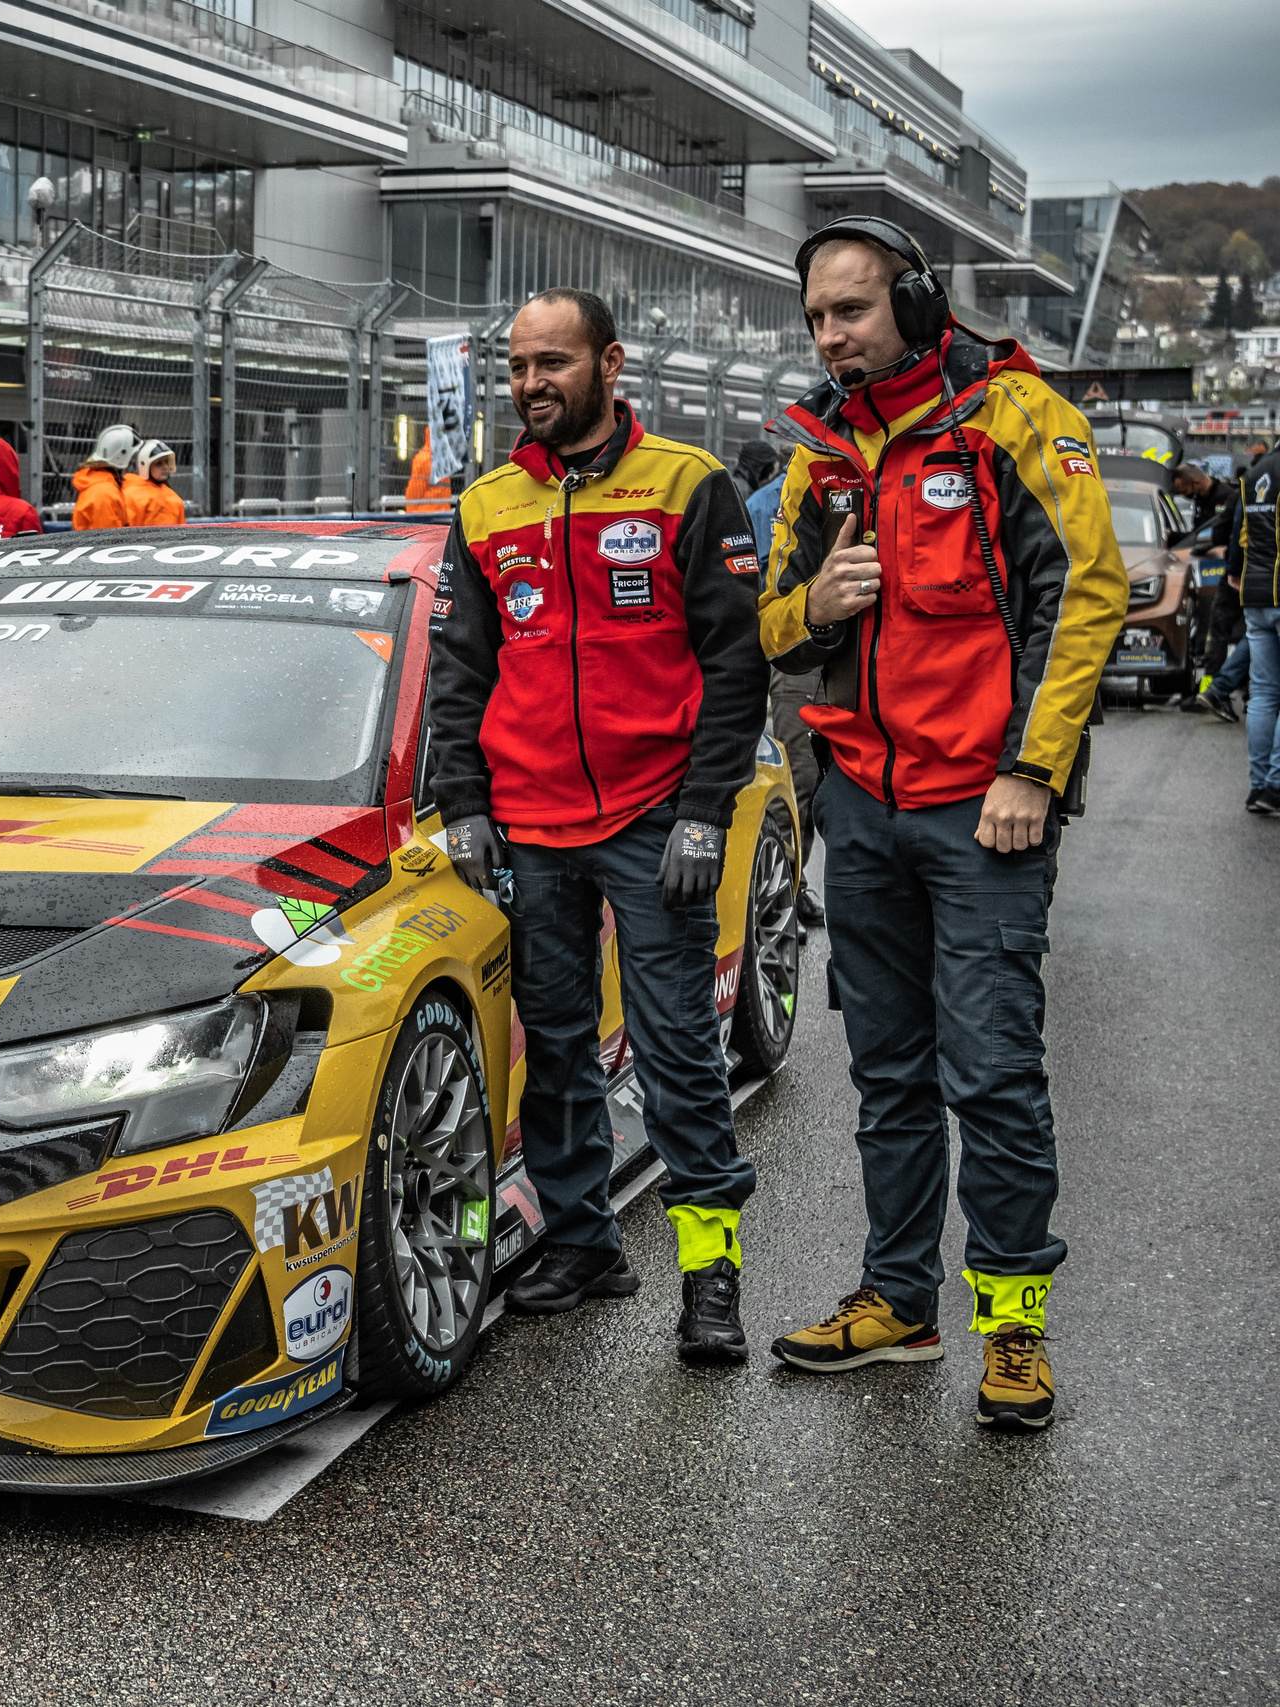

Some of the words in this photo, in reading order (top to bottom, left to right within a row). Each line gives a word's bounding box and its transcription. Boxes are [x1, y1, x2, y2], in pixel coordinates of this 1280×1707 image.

[611, 486, 656, 500] DHL
[520, 500, 538, 511] Sport
[604, 533, 657, 550] eurol
[500, 556, 533, 571] PRESTIGE
[224, 584, 272, 593] CIAO
[612, 579, 649, 588] TRICORP
[911, 582, 954, 594] comtoyou
[219, 592, 315, 604] MARCELA
[513, 596, 532, 610] ASC
[615, 597, 651, 606] WORKWEAR
[602, 613, 642, 622] comtoyou
[682, 849, 718, 860] MaxiFlex
[340, 902, 468, 993] GREENTECH
[95, 1145, 268, 1201] DHL
[281, 1172, 362, 1261] KW
[285, 1228, 359, 1273] kwsuspensions.de
[494, 1225, 522, 1268] ÖHLINS
[1021, 1283, 1049, 1310] 02
[286, 1286, 349, 1343] eurol
[287, 1317, 349, 1353] LUBRICANTS
[404, 1333, 452, 1383] EAGLE
[220, 1360, 338, 1420] GOODYEAR
